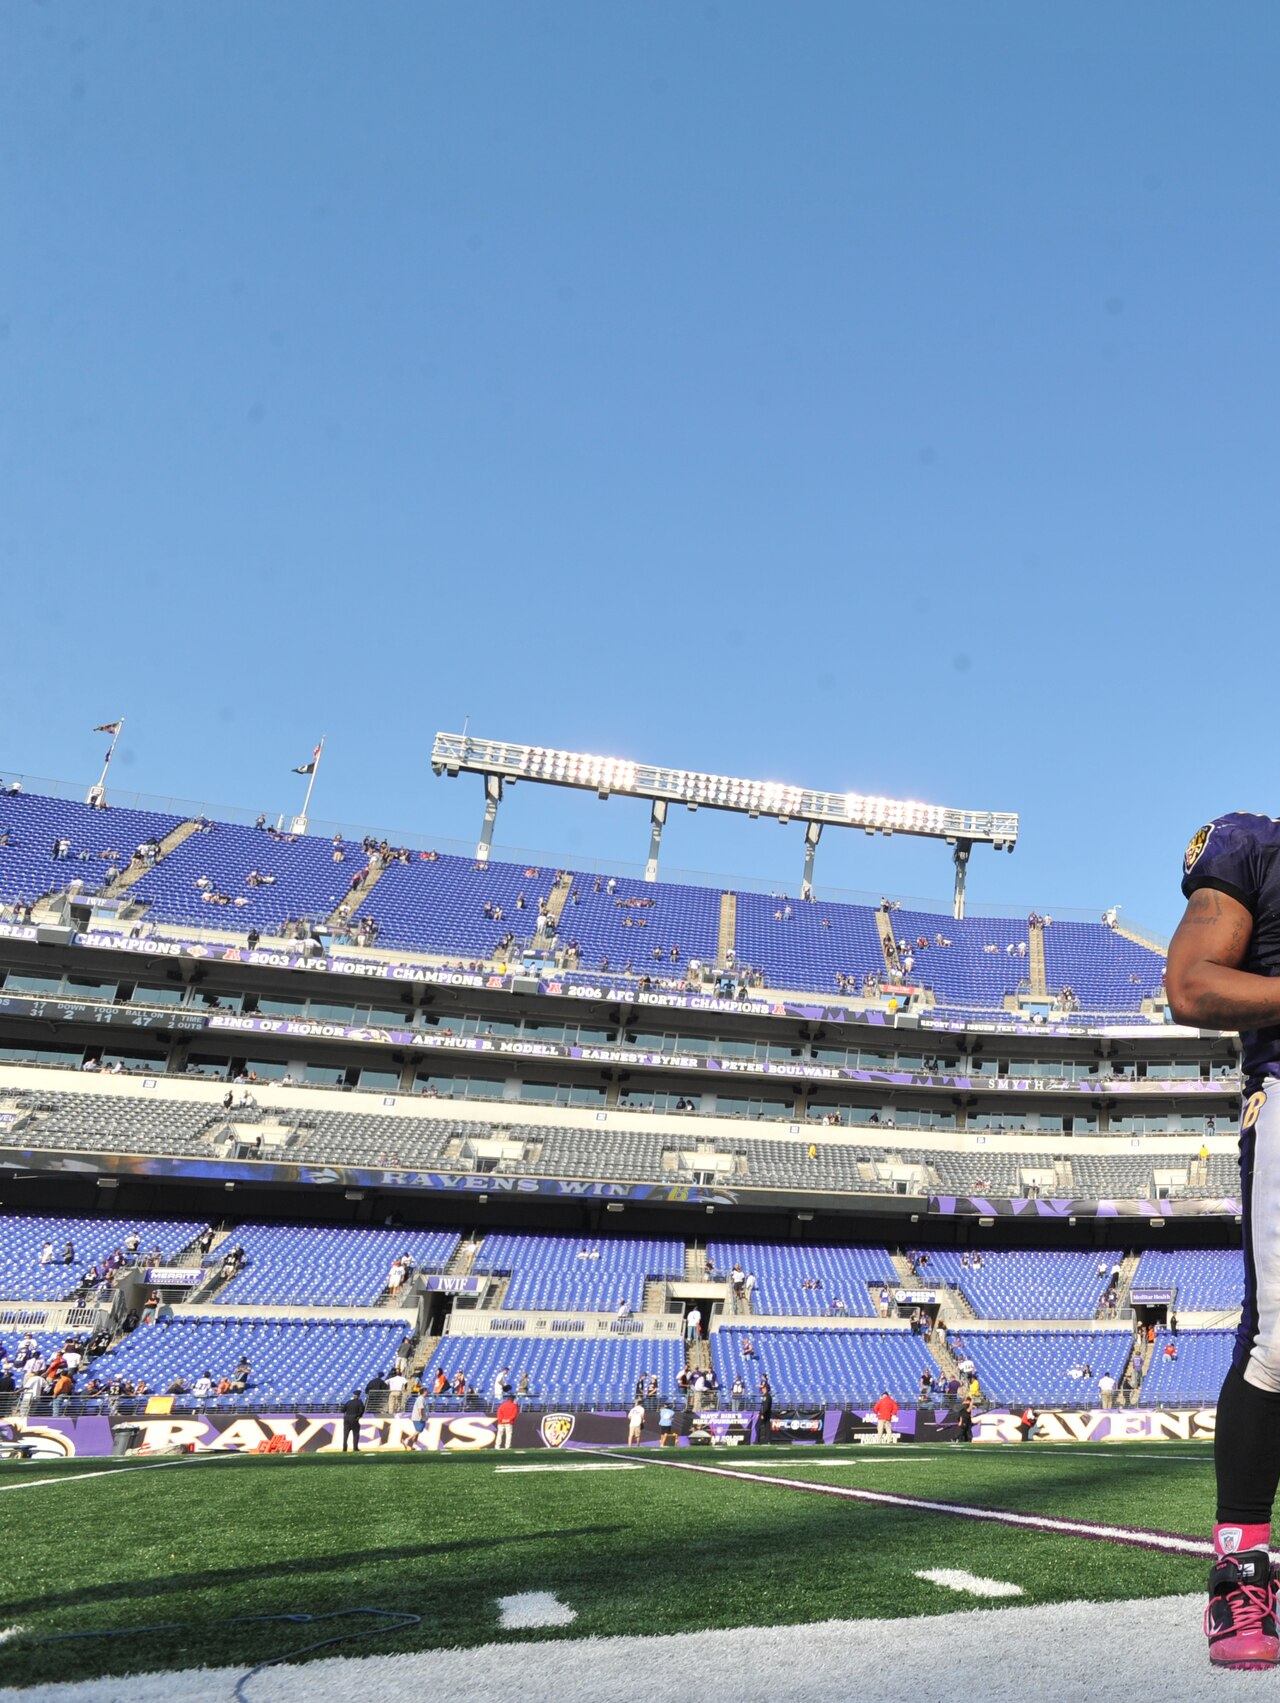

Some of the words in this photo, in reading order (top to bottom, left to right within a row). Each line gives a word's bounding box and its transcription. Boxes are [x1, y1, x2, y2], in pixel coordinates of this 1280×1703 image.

[75, 933, 181, 955] CHAMPIONS
[249, 953, 289, 967] 2003
[294, 958, 329, 970] AFC
[332, 961, 389, 977] NORTH
[393, 968, 483, 986] CHAMPIONS
[568, 985, 602, 999] 2006
[606, 989, 634, 1002] AFC
[638, 993, 687, 1007] NORTH
[691, 999, 769, 1014] CHAMPIONS
[57, 1003, 86, 1011] DOWN
[63, 1010, 74, 1020] 2
[94, 1013, 113, 1023] 11
[125, 1009, 148, 1018] BALL
[132, 1017, 152, 1027] 47
[211, 1016, 254, 1029] RING
[260, 1021, 281, 1031] OF
[288, 1024, 345, 1037] HONOR
[412, 1035, 476, 1049] ARTHUR
[482, 1040, 494, 1050] B.
[499, 1043, 558, 1056] MODELL
[582, 1050, 648, 1064] EARNEST
[652, 1056, 698, 1067] BYNER
[721, 1061, 764, 1072] PETER
[769, 1064, 840, 1078] BOULWARE
[988, 1079, 1043, 1090] SMYTH
[1242, 1091, 1267, 1130] B
[380, 1171, 539, 1192] RAVENS
[558, 1181, 634, 1196] WIN
[437, 1278, 467, 1290] IWIF
[771, 1421, 791, 1430] NFL
[801, 1421, 819, 1429] CBS
[973, 1411, 1216, 1443] RAVENS
[135, 1418, 499, 1452] RAVENS
